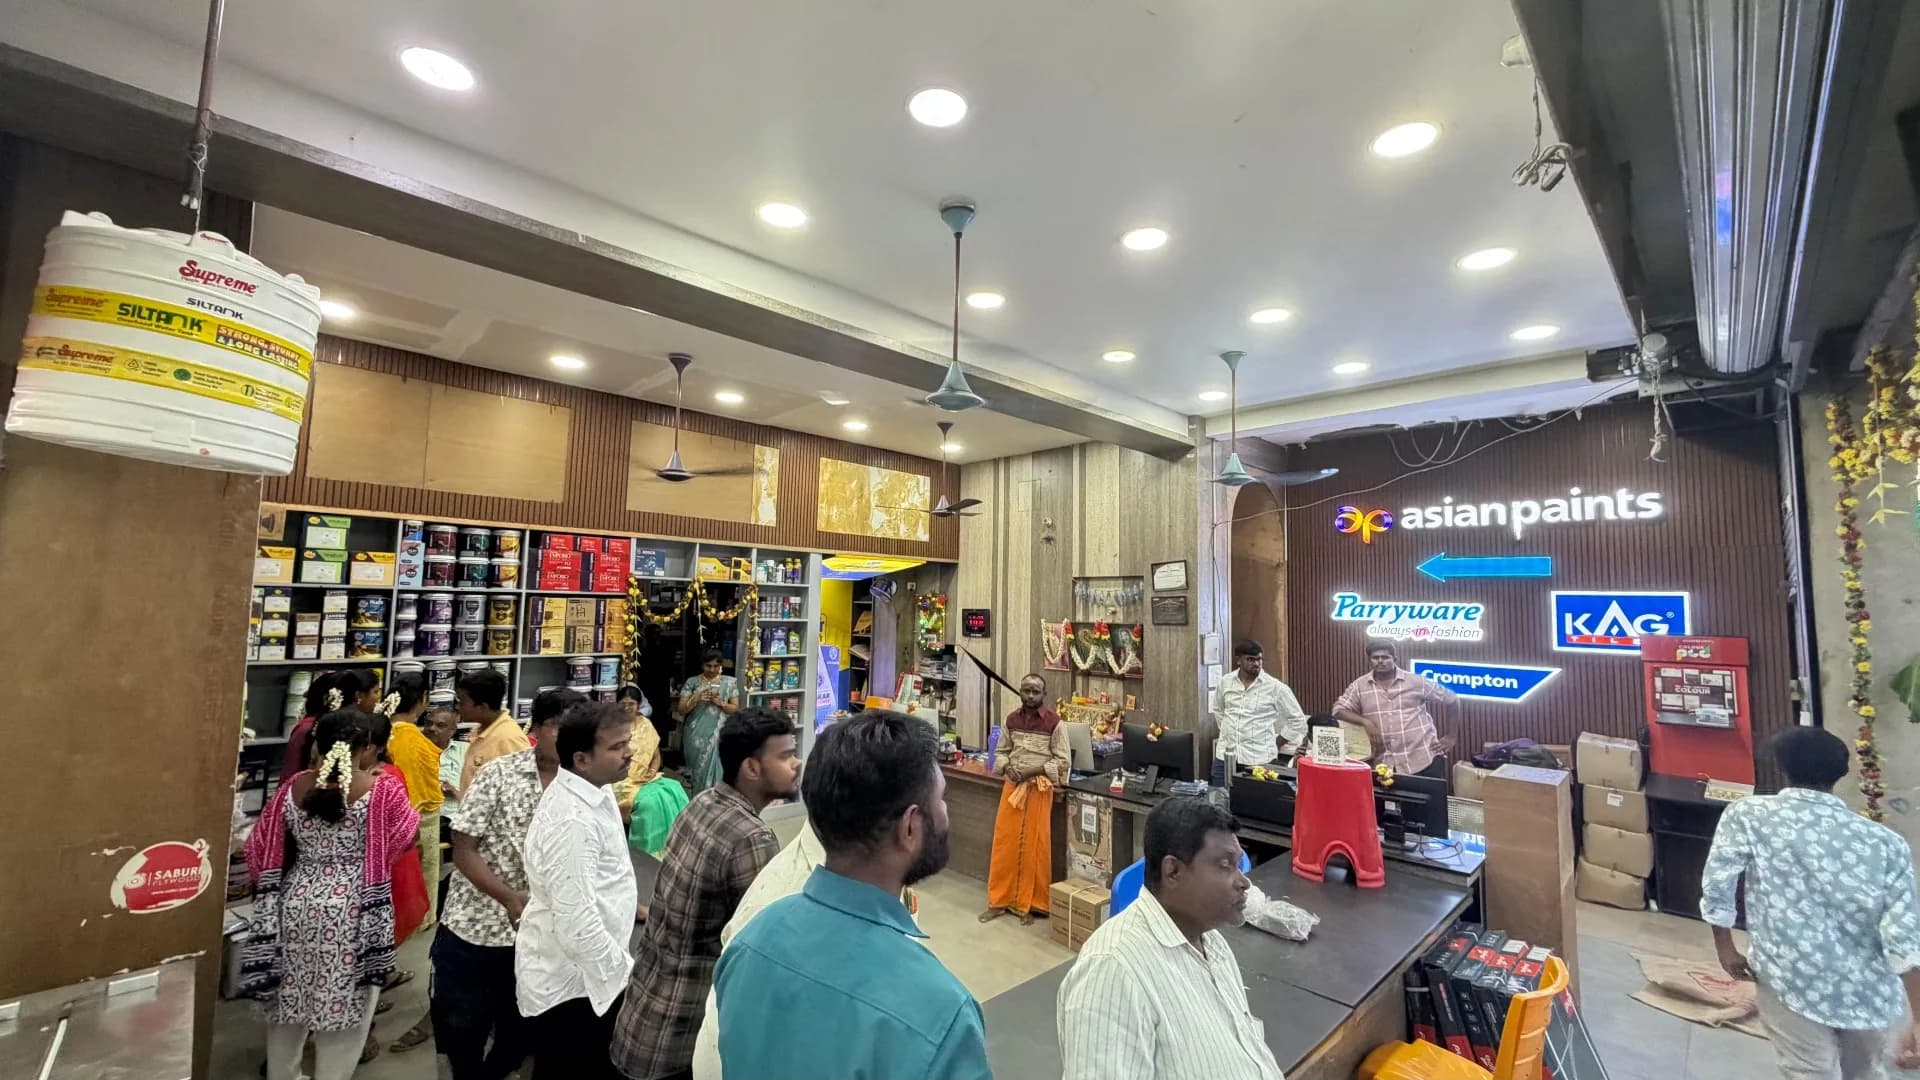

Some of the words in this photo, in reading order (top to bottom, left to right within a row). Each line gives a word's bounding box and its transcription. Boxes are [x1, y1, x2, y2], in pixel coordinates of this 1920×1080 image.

[179, 259, 257, 293] Supreme
[1335, 595, 1481, 624] Parryware
[1564, 599, 1669, 636] KAG
[1369, 624, 1411, 638] always
[1413, 625, 1428, 636] in
[1430, 625, 1480, 638] fashion
[1420, 669, 1518, 689] Crompton
[1674, 686, 1711, 694] COLOUR
